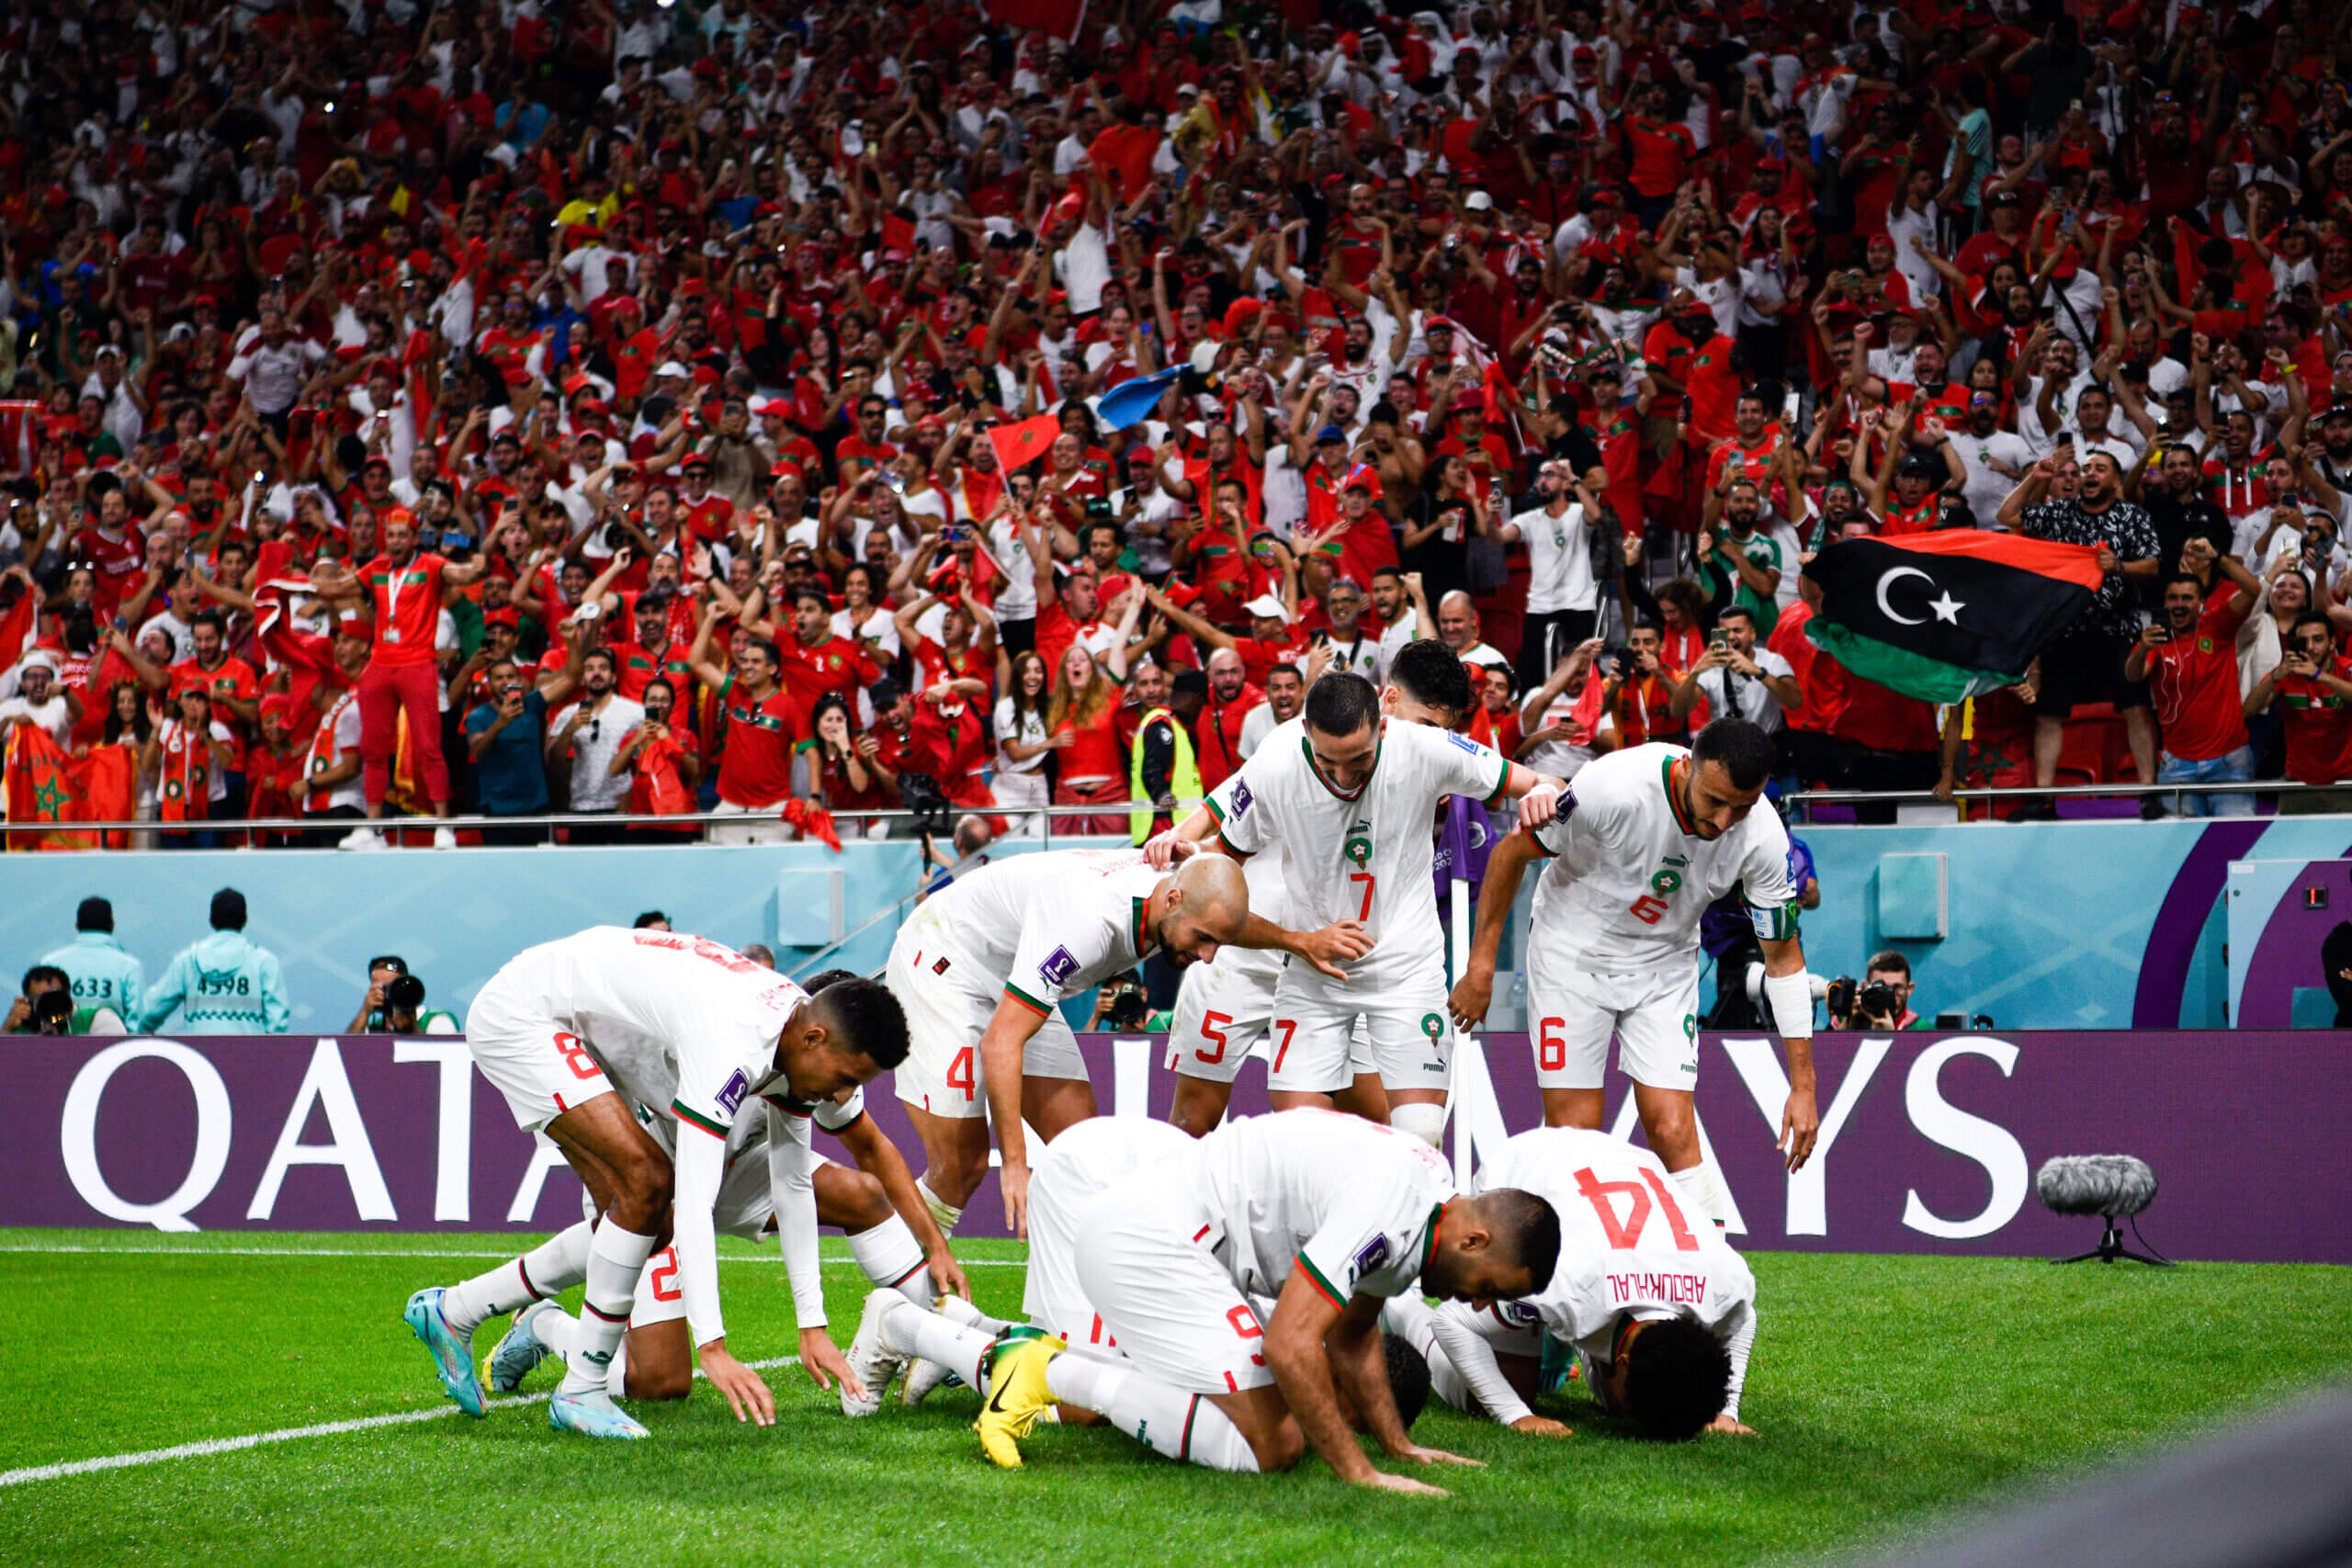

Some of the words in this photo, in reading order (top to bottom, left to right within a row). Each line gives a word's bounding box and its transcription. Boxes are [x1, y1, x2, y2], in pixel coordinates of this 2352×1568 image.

[1350, 872, 1375, 922] 7
[1629, 895, 1669, 925] 6
[553, 1032, 603, 1080] 8
[1195, 1009, 1233, 1065] 5
[1272, 1019, 1297, 1073] 7
[1540, 1016, 1566, 1071] 6
[946, 1045, 976, 1102] 4
[61, 1038, 574, 1233] QAT
[1573, 1167, 1700, 1251] 14
[647, 1246, 682, 1303] 2
[1606, 1273, 1706, 1304] ABOUKHLAL
